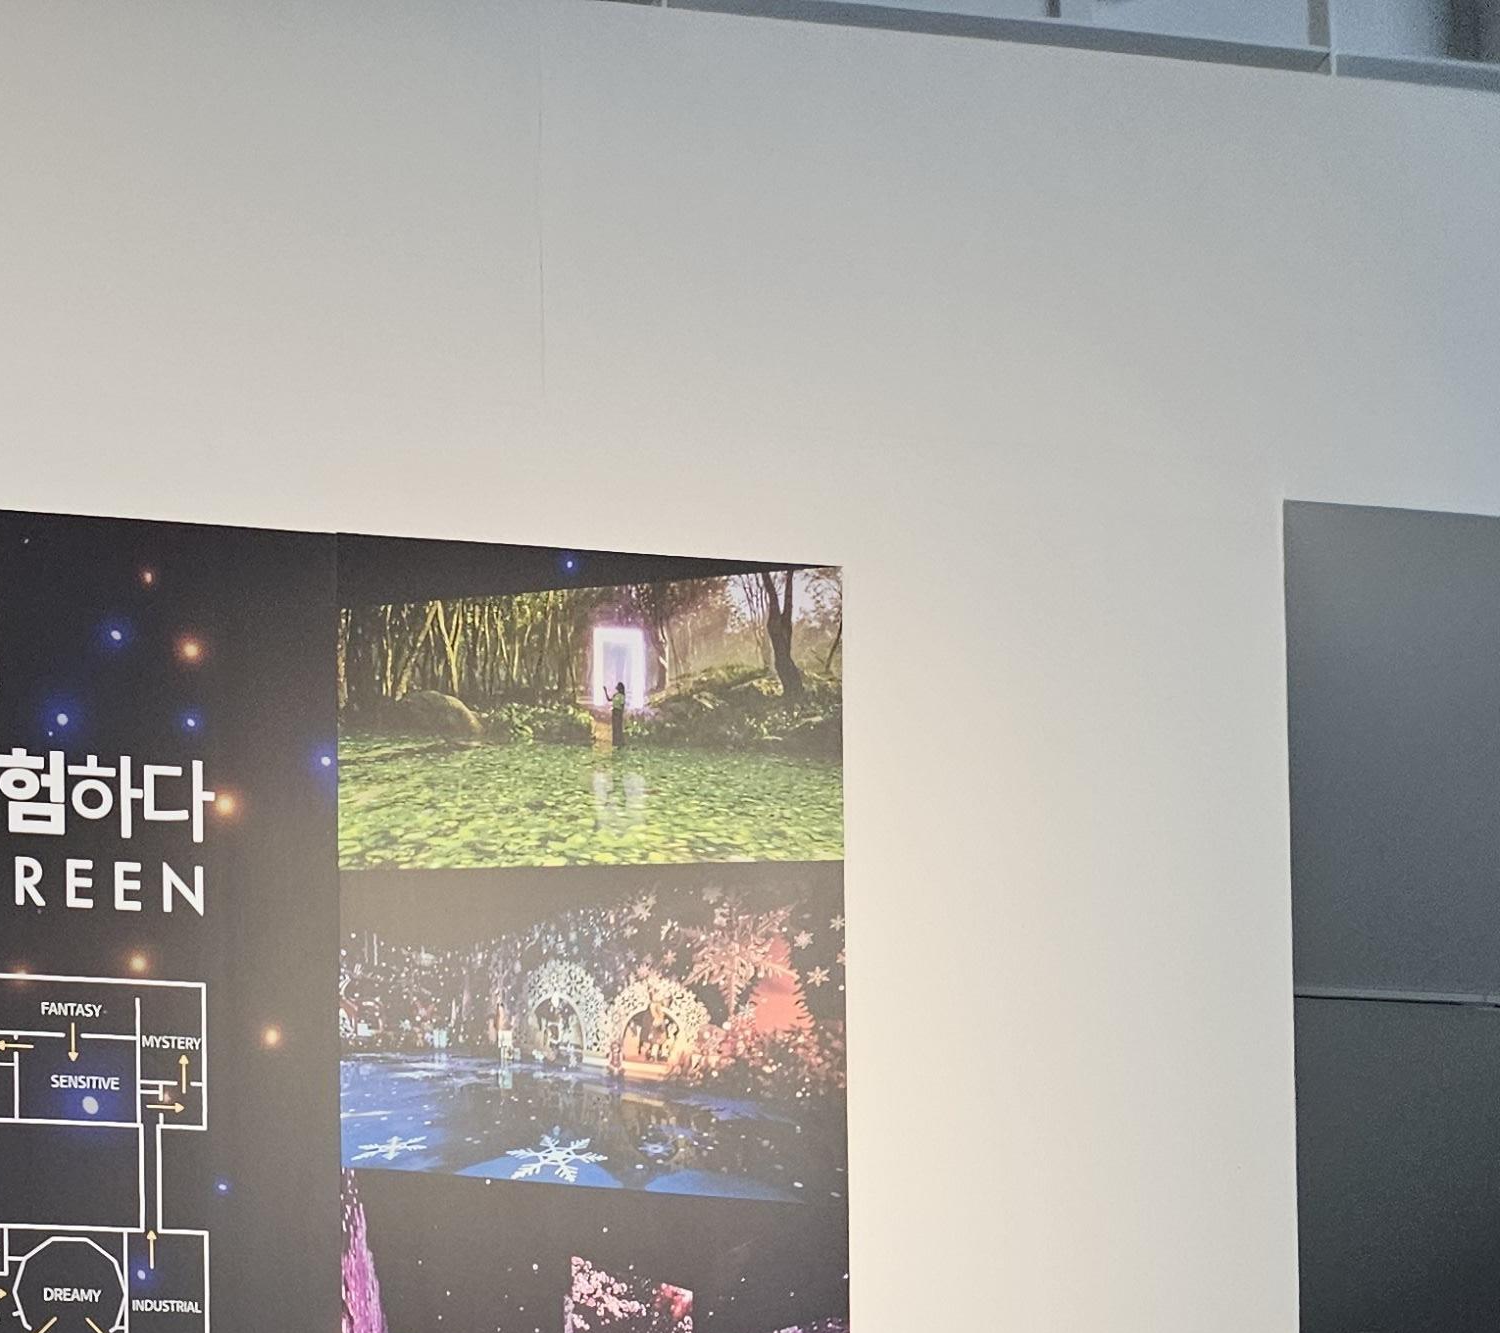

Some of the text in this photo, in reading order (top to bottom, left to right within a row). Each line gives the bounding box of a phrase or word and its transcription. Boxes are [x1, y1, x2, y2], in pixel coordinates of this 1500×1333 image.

[41, 1001, 102, 1018] FANTASY
[141, 1035, 201, 1051] MYSTERY
[50, 1074, 120, 1091] SENSITIVE
[43, 1286, 102, 1303] DREAMY
[131, 1298, 202, 1314] INDUSTRIAL
